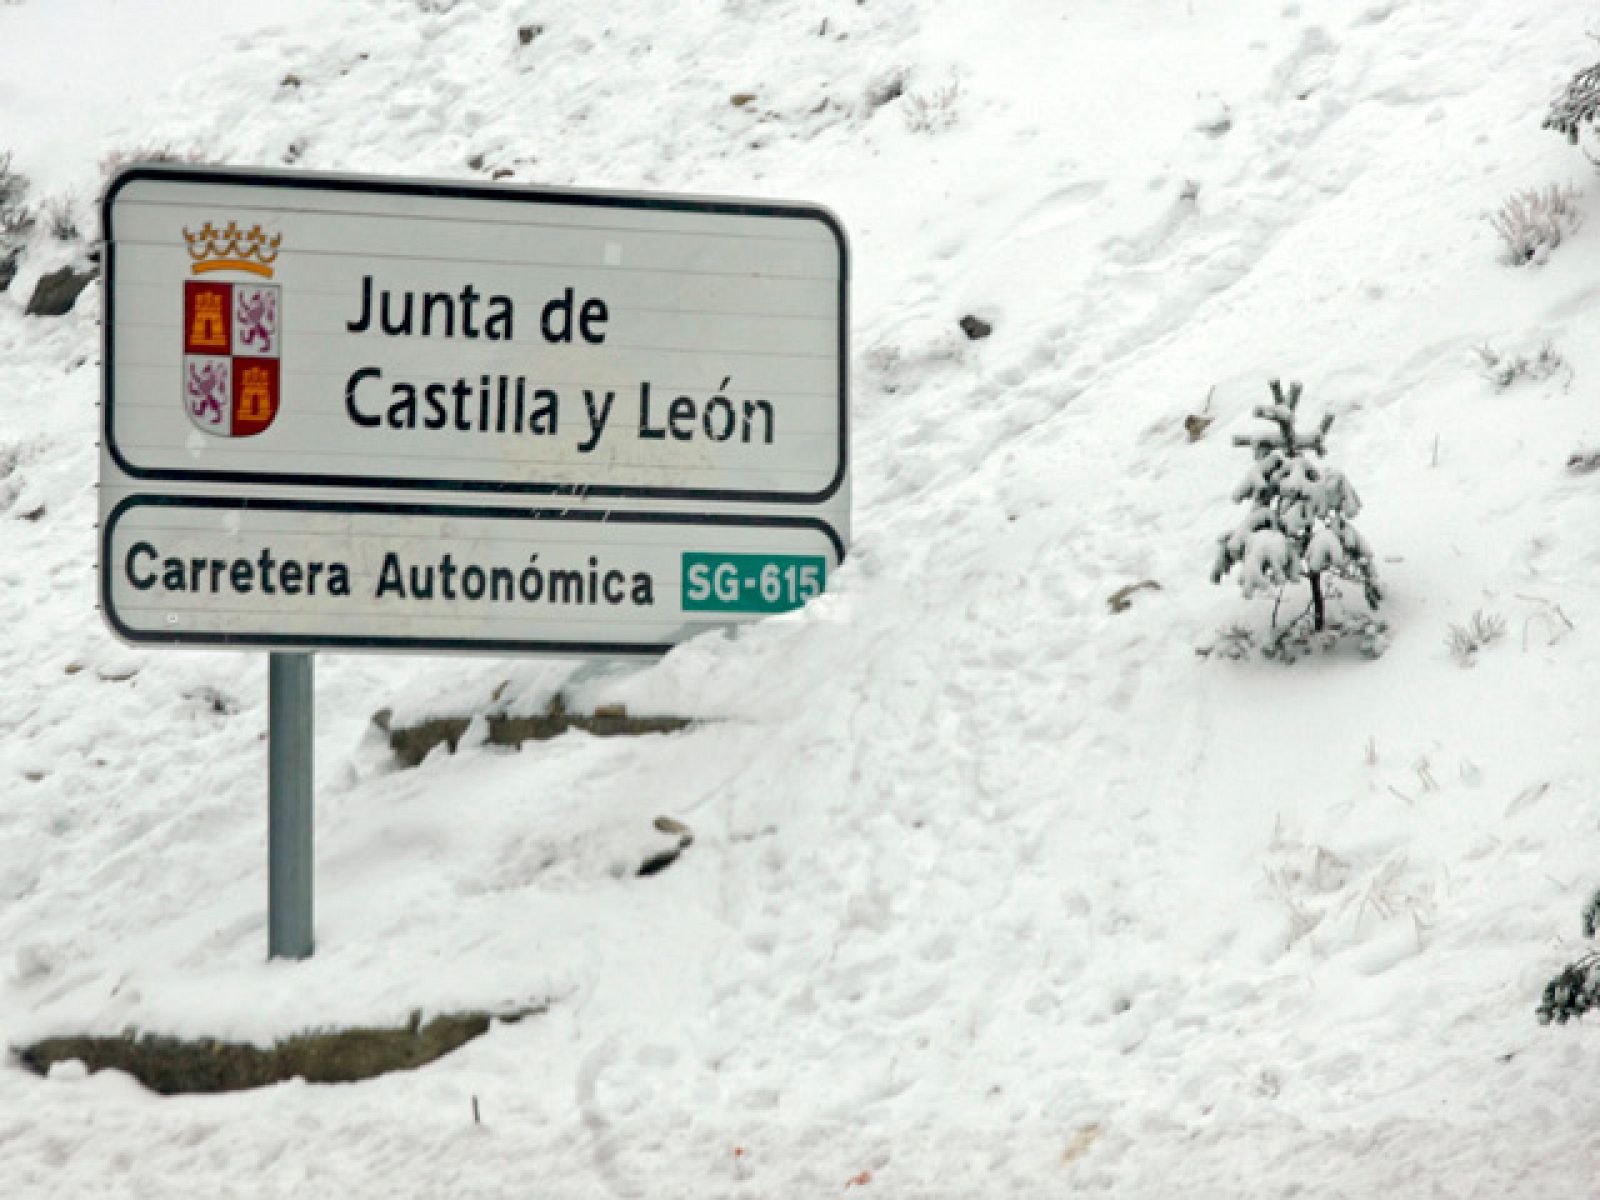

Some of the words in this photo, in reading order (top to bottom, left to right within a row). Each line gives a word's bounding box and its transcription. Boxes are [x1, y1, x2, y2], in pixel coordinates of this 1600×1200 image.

[345, 274, 514, 341] Junta
[540, 286, 609, 346] de
[344, 366, 560, 436] Castilla
[576, 389, 616, 453] y
[638, 376, 775, 445] León
[124, 541, 351, 597] Carretera
[375, 551, 655, 607] Autonómica
[686, 561, 822, 603] SG-615
